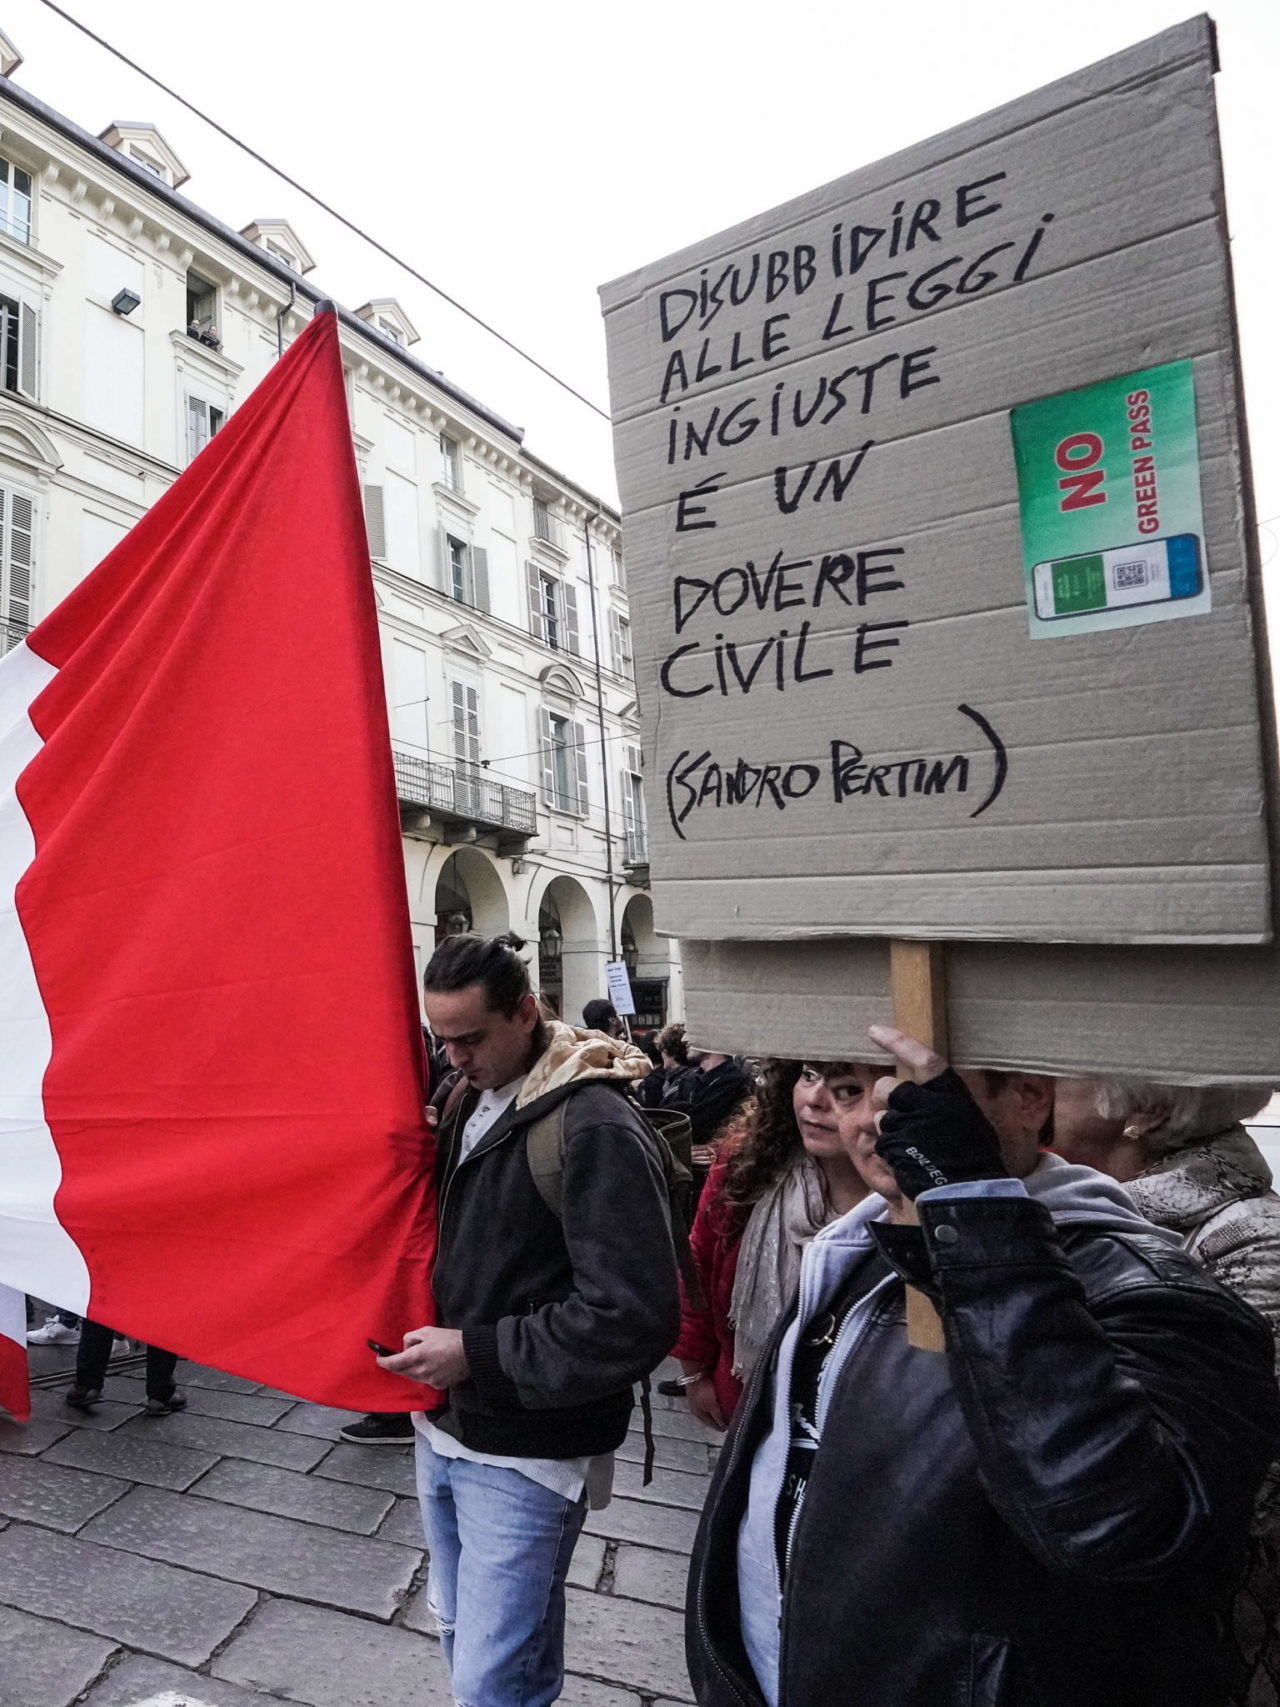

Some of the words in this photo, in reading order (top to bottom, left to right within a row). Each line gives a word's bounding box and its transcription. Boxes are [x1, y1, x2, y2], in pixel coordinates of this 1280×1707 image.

[659, 171, 1007, 342] DISUBBIDIRE
[660, 313, 790, 405] ALLE
[822, 212, 1055, 342] LEGGI
[667, 346, 941, 465] INGIUSTE
[1126, 389, 1152, 451] PASS
[775, 440, 875, 514] UN
[1055, 432, 1107, 512] NO
[1133, 455, 1161, 535] GREEN
[674, 547, 906, 634] DOVERE
[660, 620, 910, 698] CIVILE
